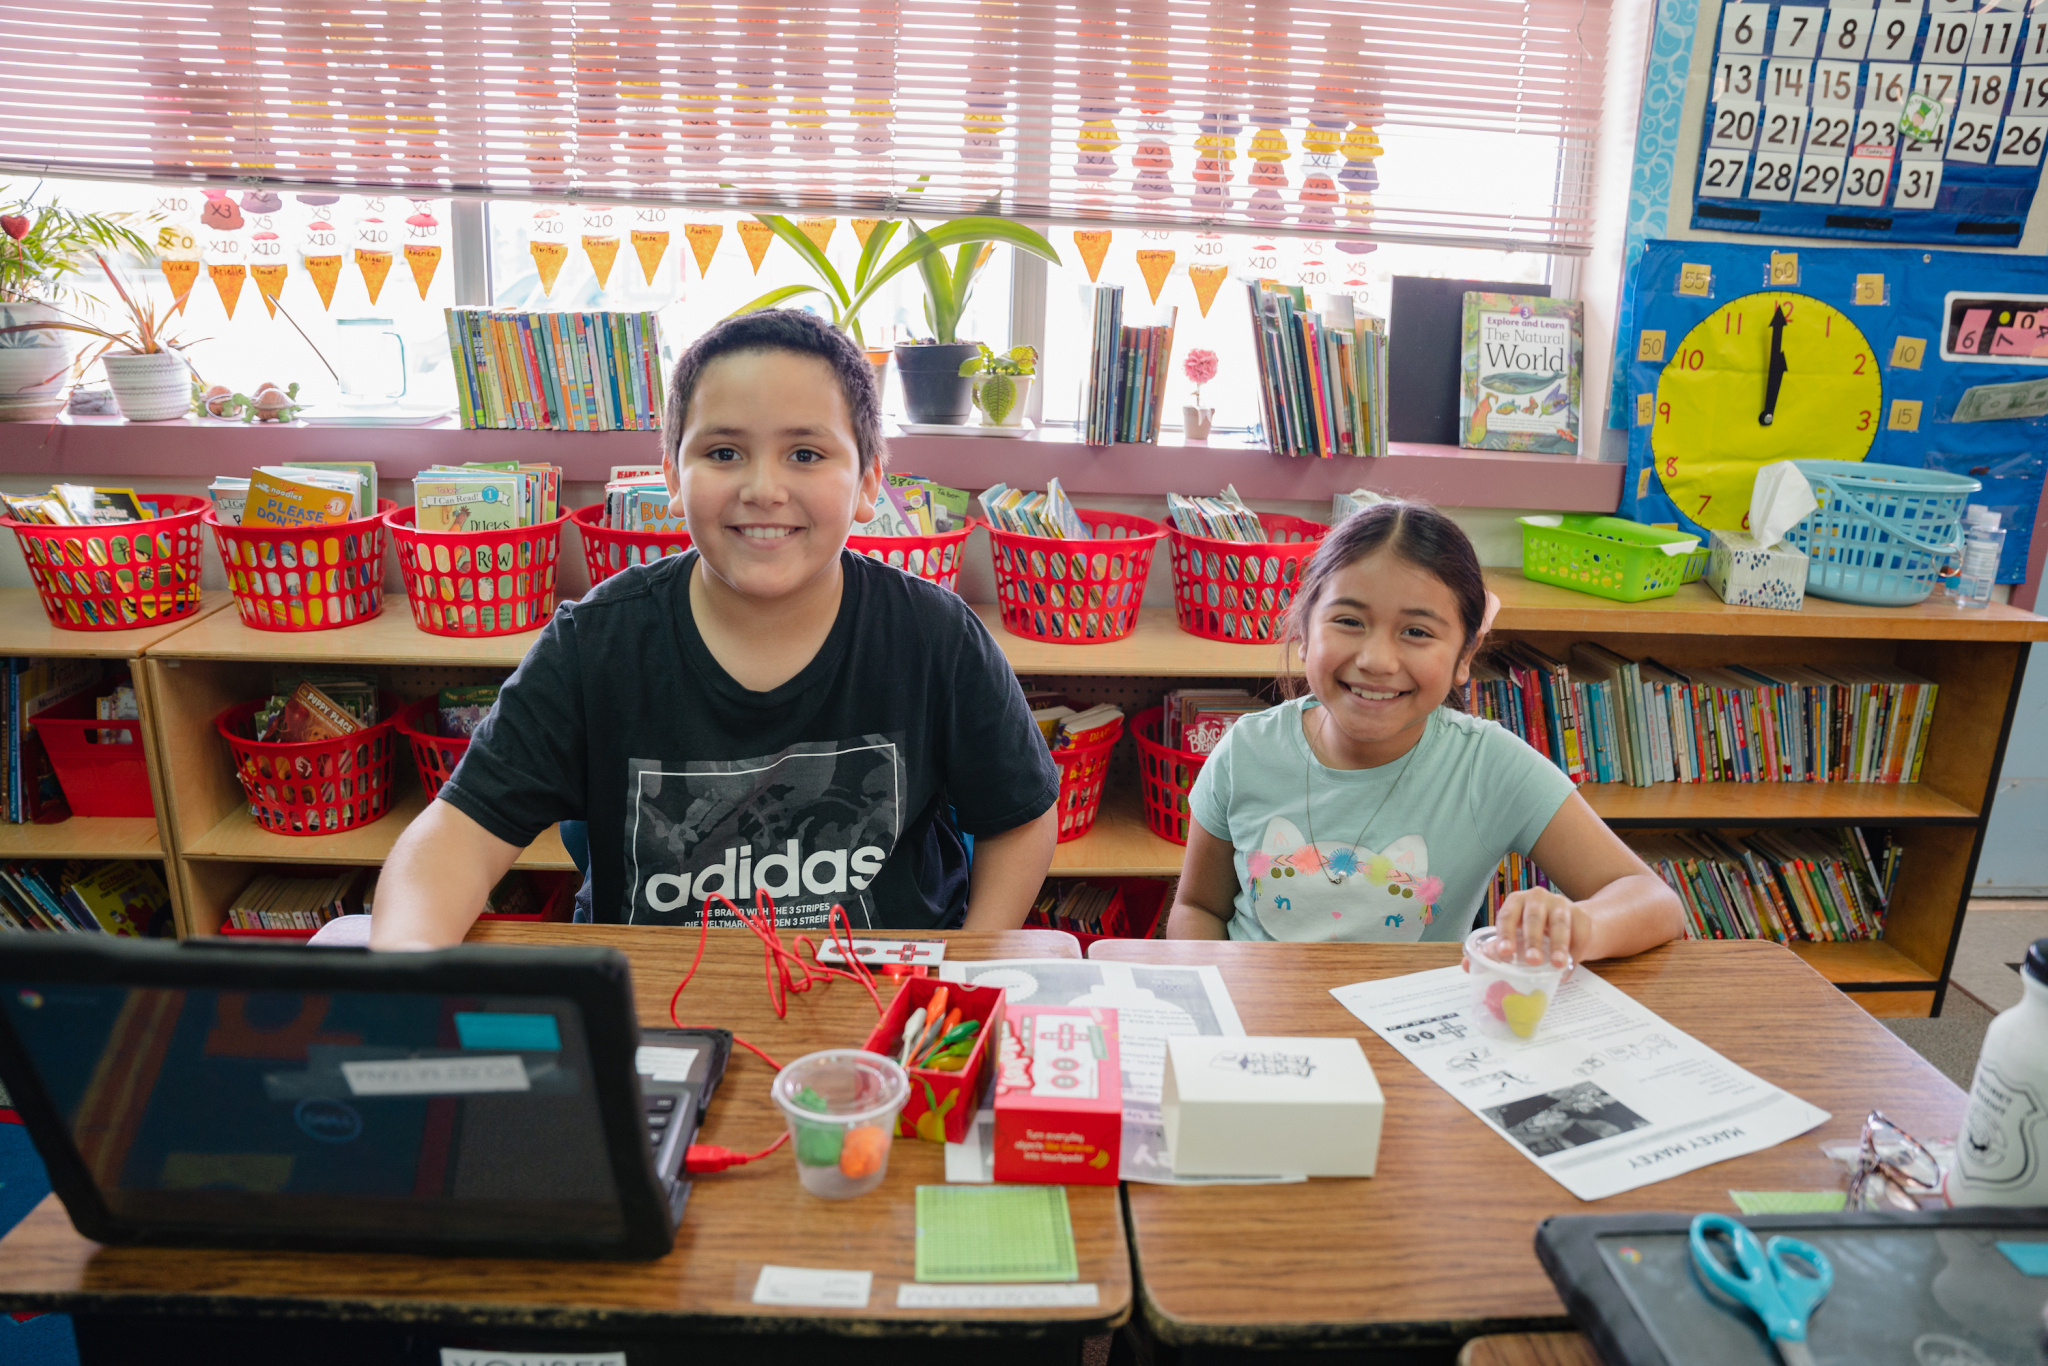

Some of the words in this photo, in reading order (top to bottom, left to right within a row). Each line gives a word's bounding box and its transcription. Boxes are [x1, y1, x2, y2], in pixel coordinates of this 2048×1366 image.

[1736, 15, 1752, 44] 6
[1790, 18, 1808, 46] 7
[1839, 18, 1858, 49] 8
[1887, 20, 1906, 50] 9
[1934, 23, 1968, 54] 10
[1982, 23, 2012, 54] 11
[1724, 64, 1752, 94] 13
[1774, 68, 1803, 96] 14
[1822, 70, 1850, 100] 15
[1874, 72, 1903, 102] 16
[1923, 74, 1954, 101] 17
[1970, 76, 2001, 105] 18
[2024, 78, 2048, 107] 19
[1718, 109, 1754, 140] 20
[1768, 114, 1800, 144] 21
[1812, 117, 1849, 148] 22
[1860, 122, 1896, 147] 23
[1954, 122, 1992, 152] 25
[2004, 126, 2042, 156] 26
[1706, 158, 1744, 188] 27
[1755, 162, 1792, 192] 28
[1801, 165, 1840, 194] 29
[1847, 168, 1885, 197] 30
[1904, 170, 1934, 198] 31
[157, 198, 188, 211] X10
[211, 204, 232, 218] X3
[365, 198, 385, 212] X5
[312, 206, 332, 220] X5
[636, 209, 666, 222] X10
[252, 216, 272, 230] X5
[534, 220, 564, 234] X10
[584, 215, 612, 228] X10
[307, 233, 336, 246] X10
[359, 230, 388, 242] X10
[210, 240, 238, 252] X10
[252, 242, 280, 255] X10
[1194, 242, 1222, 255] X10
[1304, 241, 1322, 255] X5
[1248, 256, 1276, 269] X10
[1348, 262, 1366, 276] X5
[1774, 262, 1794, 278] 60
[1298, 272, 1326, 284] X10
[1685, 271, 1705, 289] 55
[1865, 283, 1874, 298] 5
[1523, 308, 1528, 318] 3
[1488, 317, 1519, 327] Explore
[1522, 320, 1538, 328] and
[1541, 321, 1564, 329] Learn
[1726, 314, 1742, 335] 11
[1826, 316, 1832, 338] 1
[1485, 328, 1510, 341] The
[1514, 330, 1564, 344] Natural
[1962, 330, 1976, 348] 6
[1642, 338, 1662, 356] 50
[1900, 345, 1916, 362] 10
[1485, 343, 1564, 372] World
[1680, 349, 1704, 371] 10
[1854, 354, 1866, 375] 2
[1640, 400, 1652, 417] 45
[1658, 402, 1670, 424] 9
[1856, 411, 1872, 432] 3
[1896, 407, 1912, 425] 15
[1666, 456, 1678, 478] 8
[270, 487, 302, 500] noodles
[439, 496, 454, 504] Can
[456, 494, 478, 502] Read!
[488, 490, 492, 498] 1
[938, 488, 960, 498] Tabor
[334, 502, 340, 512] 1
[1698, 495, 1712, 516] 7
[306, 692, 331, 715] PUPPY
[329, 711, 354, 733] PLACE
[644, 838, 886, 912] adidas
[789, 906, 794, 914] 3
[796, 902, 830, 913] STRIPES
[793, 918, 798, 926] 3
[800, 914, 840, 926] STREIFN
[1687, 1124, 1745, 1150] MAKEY
[1627, 1141, 1688, 1170] MAKEY
